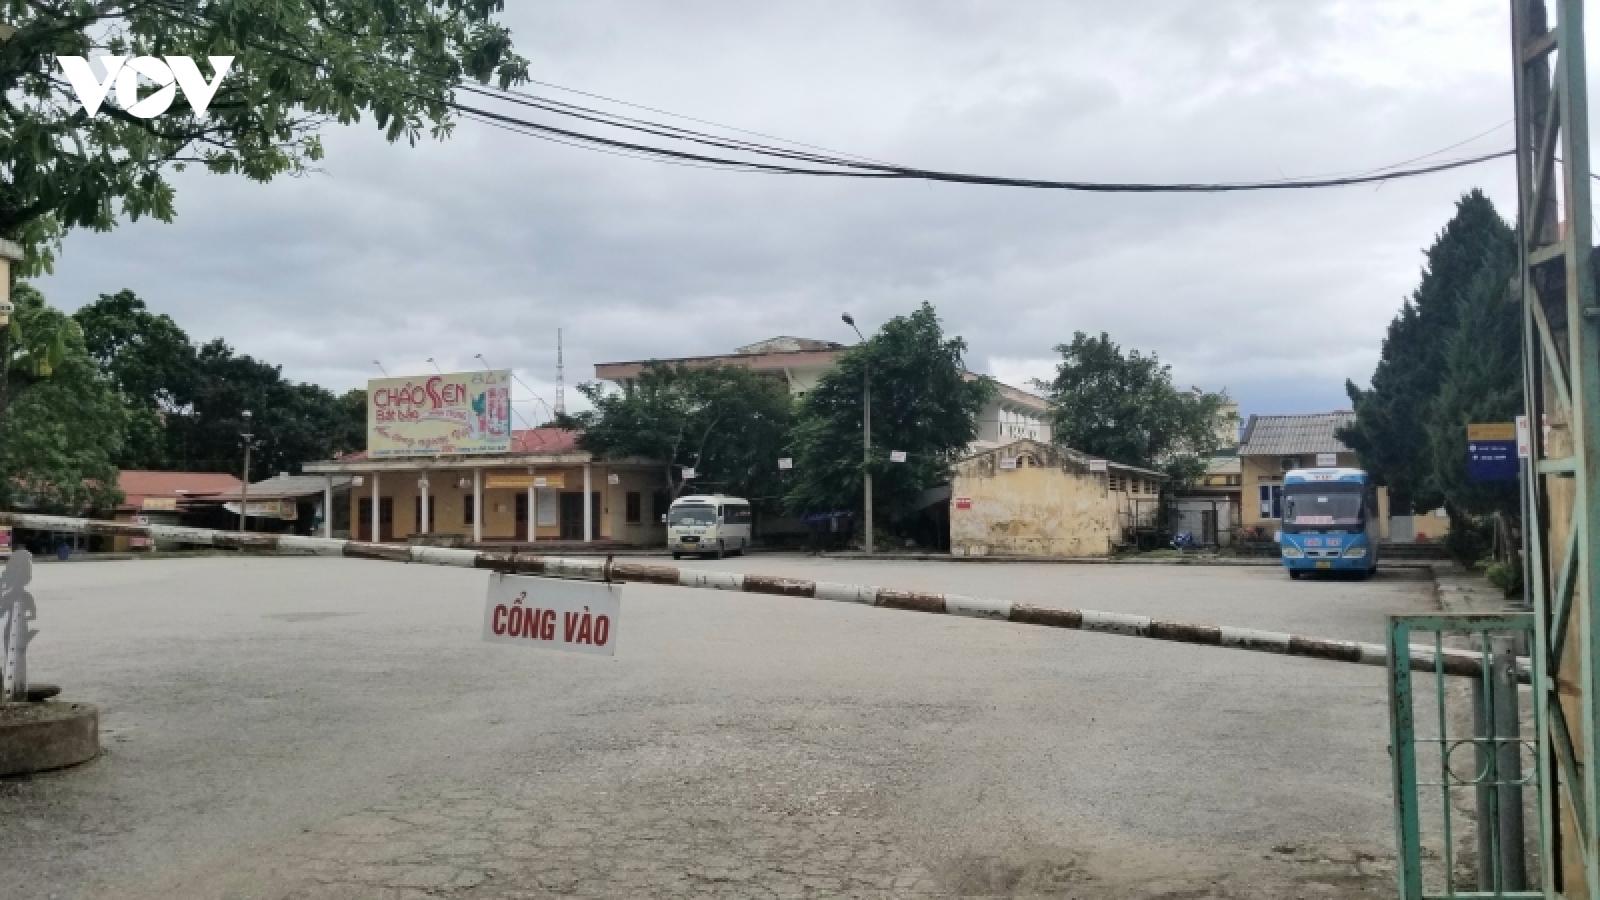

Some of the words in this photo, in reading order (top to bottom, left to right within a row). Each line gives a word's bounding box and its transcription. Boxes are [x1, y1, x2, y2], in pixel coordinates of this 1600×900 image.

[426, 376, 467, 409] SEN
[492, 590, 557, 641] CỔNG
[563, 605, 611, 647] VÀO
